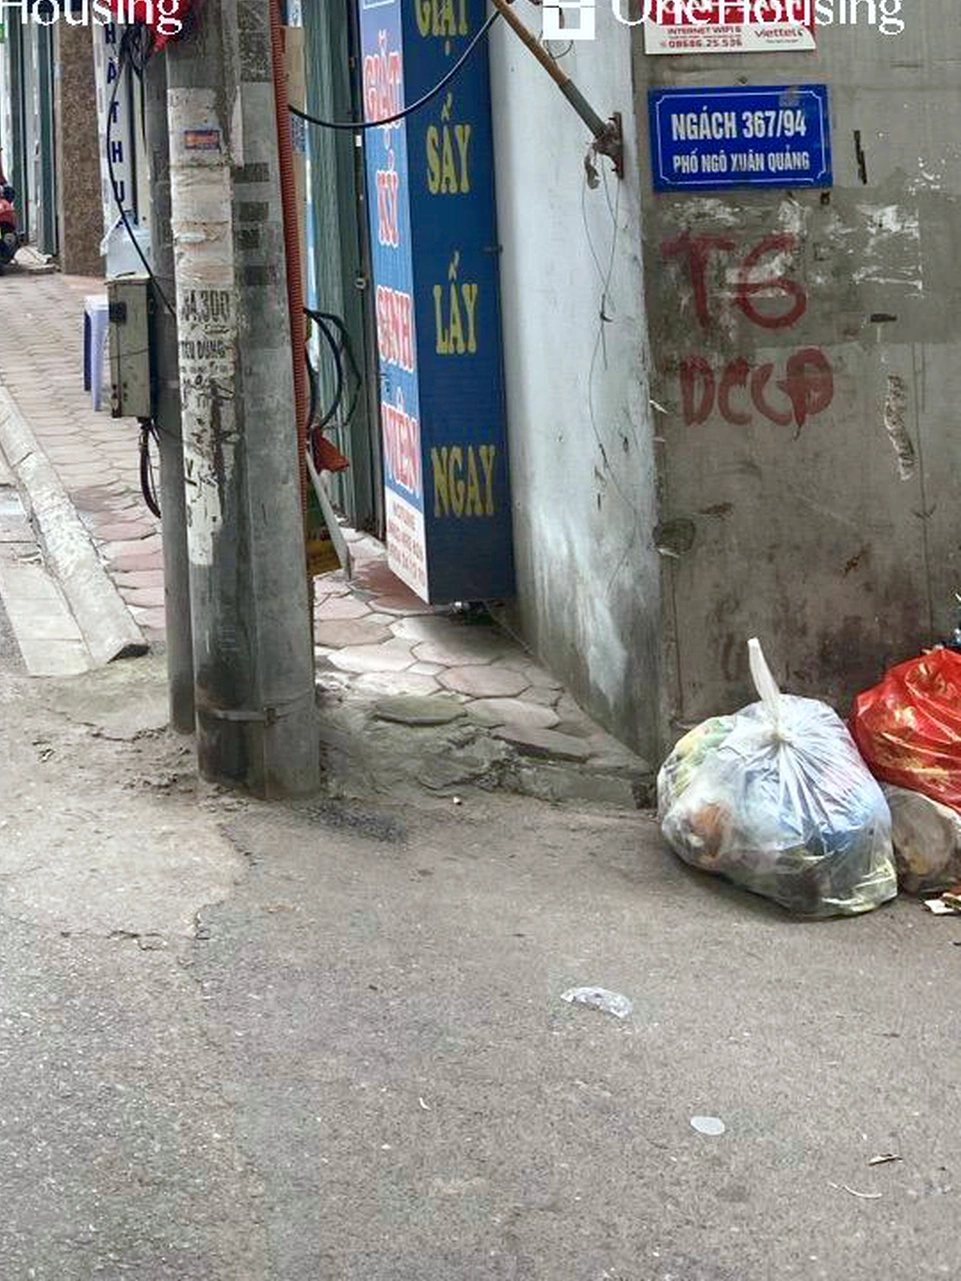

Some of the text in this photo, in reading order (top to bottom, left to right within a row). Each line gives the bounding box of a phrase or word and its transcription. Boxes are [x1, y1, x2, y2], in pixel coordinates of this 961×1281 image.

[754, 28, 797, 38] viettel
[426, 93, 471, 195] SẤY
[671, 106, 807, 141] NGÁCH 367/94
[672, 145, 810, 174] PHỐ NGÔ XUÂN QUẢNG
[433, 250, 479, 355] LẤY
[430, 444, 496, 518] NGAY
